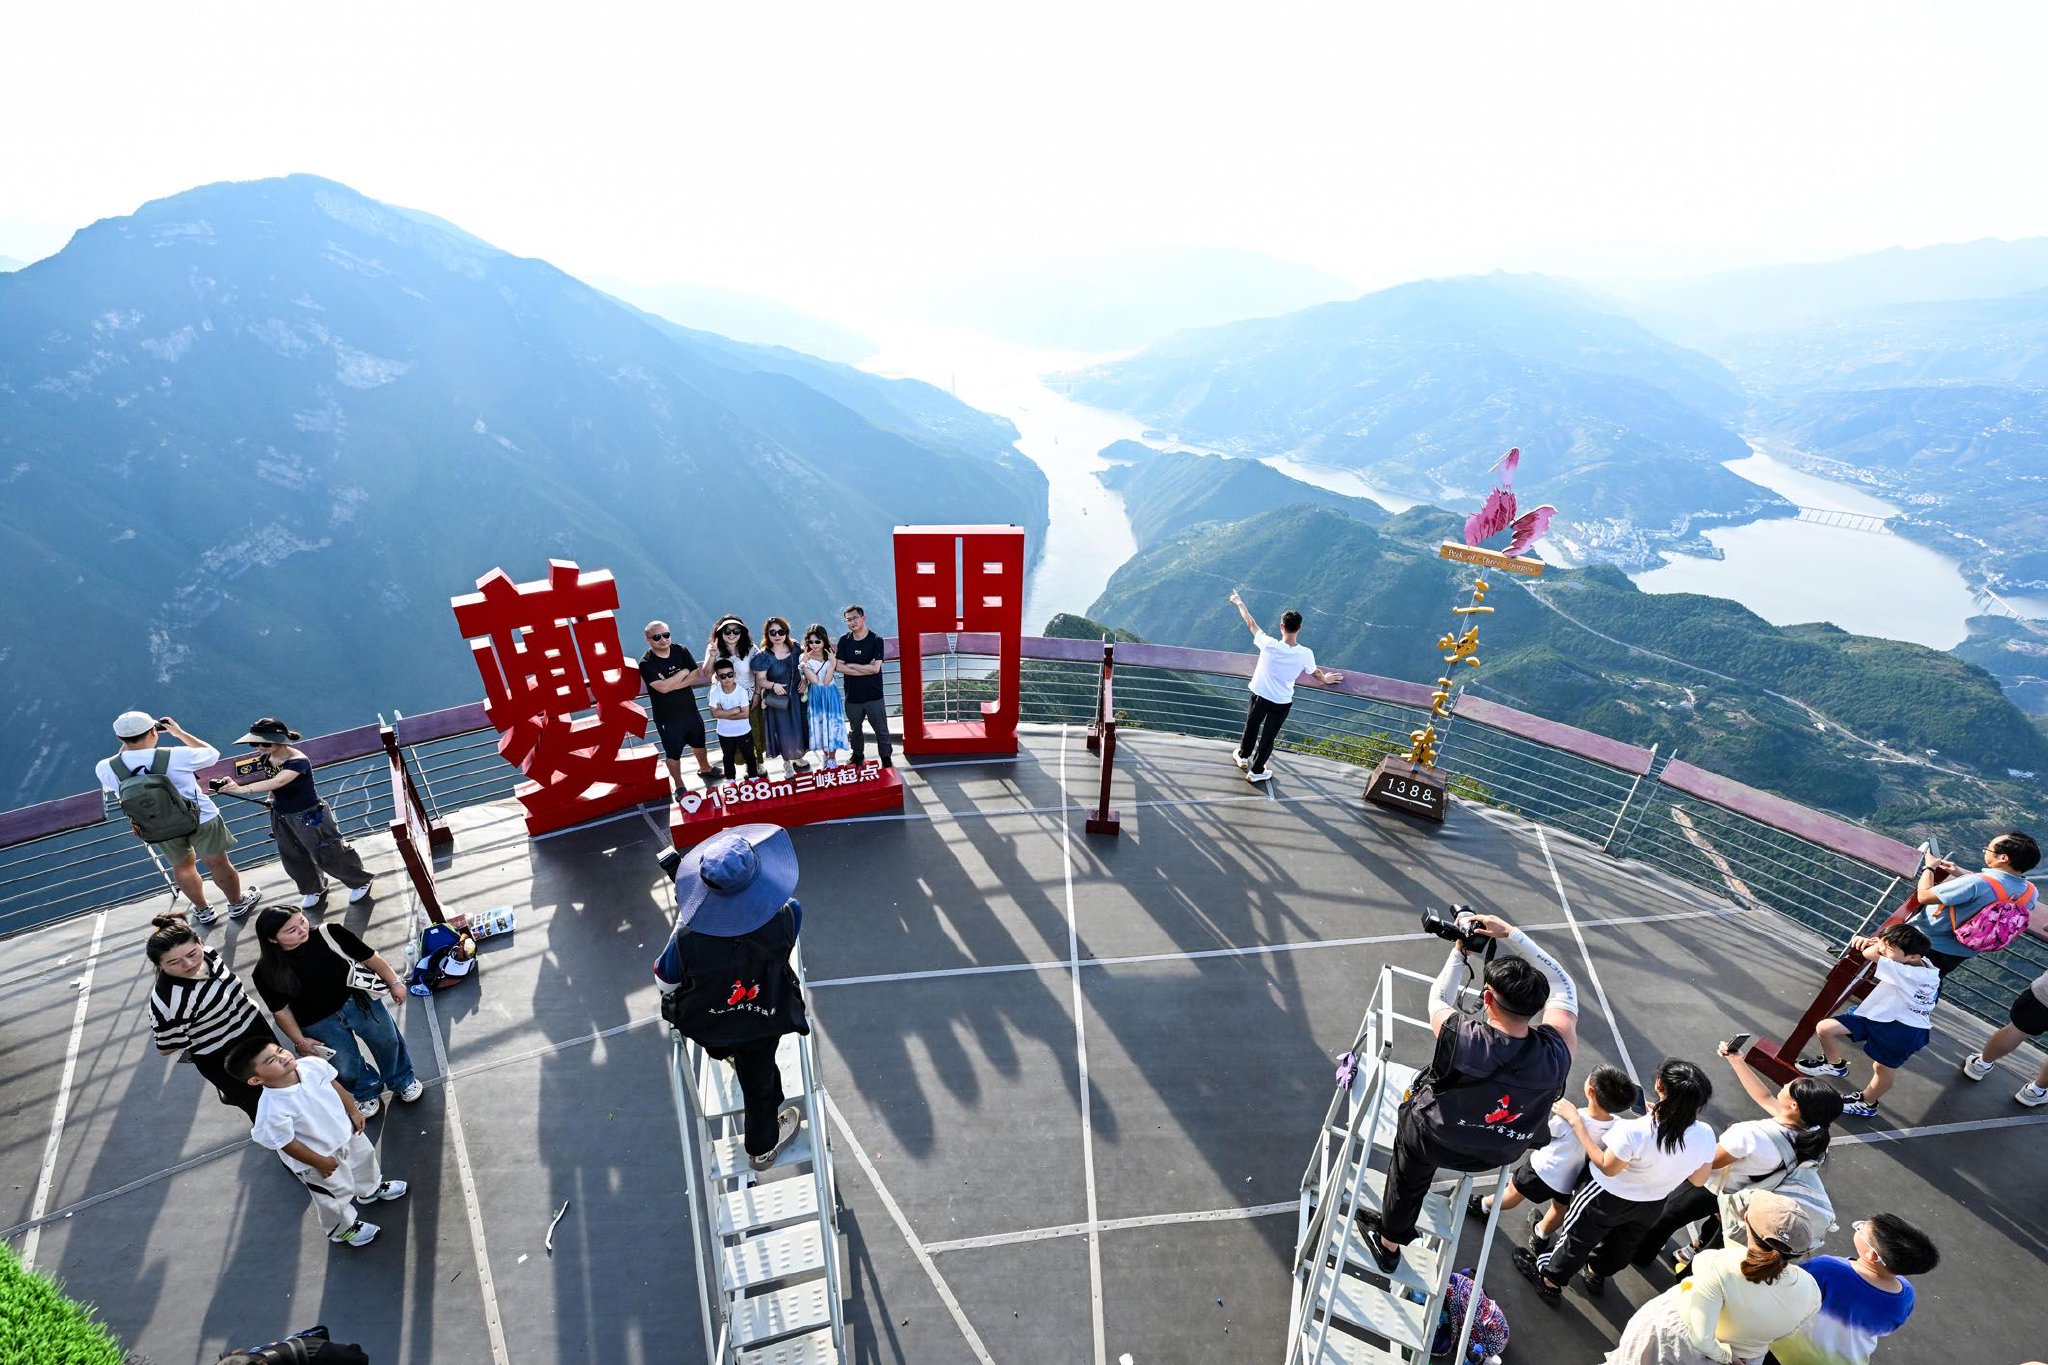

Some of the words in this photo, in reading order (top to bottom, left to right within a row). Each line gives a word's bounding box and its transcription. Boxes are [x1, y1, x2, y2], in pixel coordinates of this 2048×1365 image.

[1467, 553, 1476, 561] of
[1482, 556, 1502, 566] Three
[1537, 954, 1574, 1000] RUBICON
